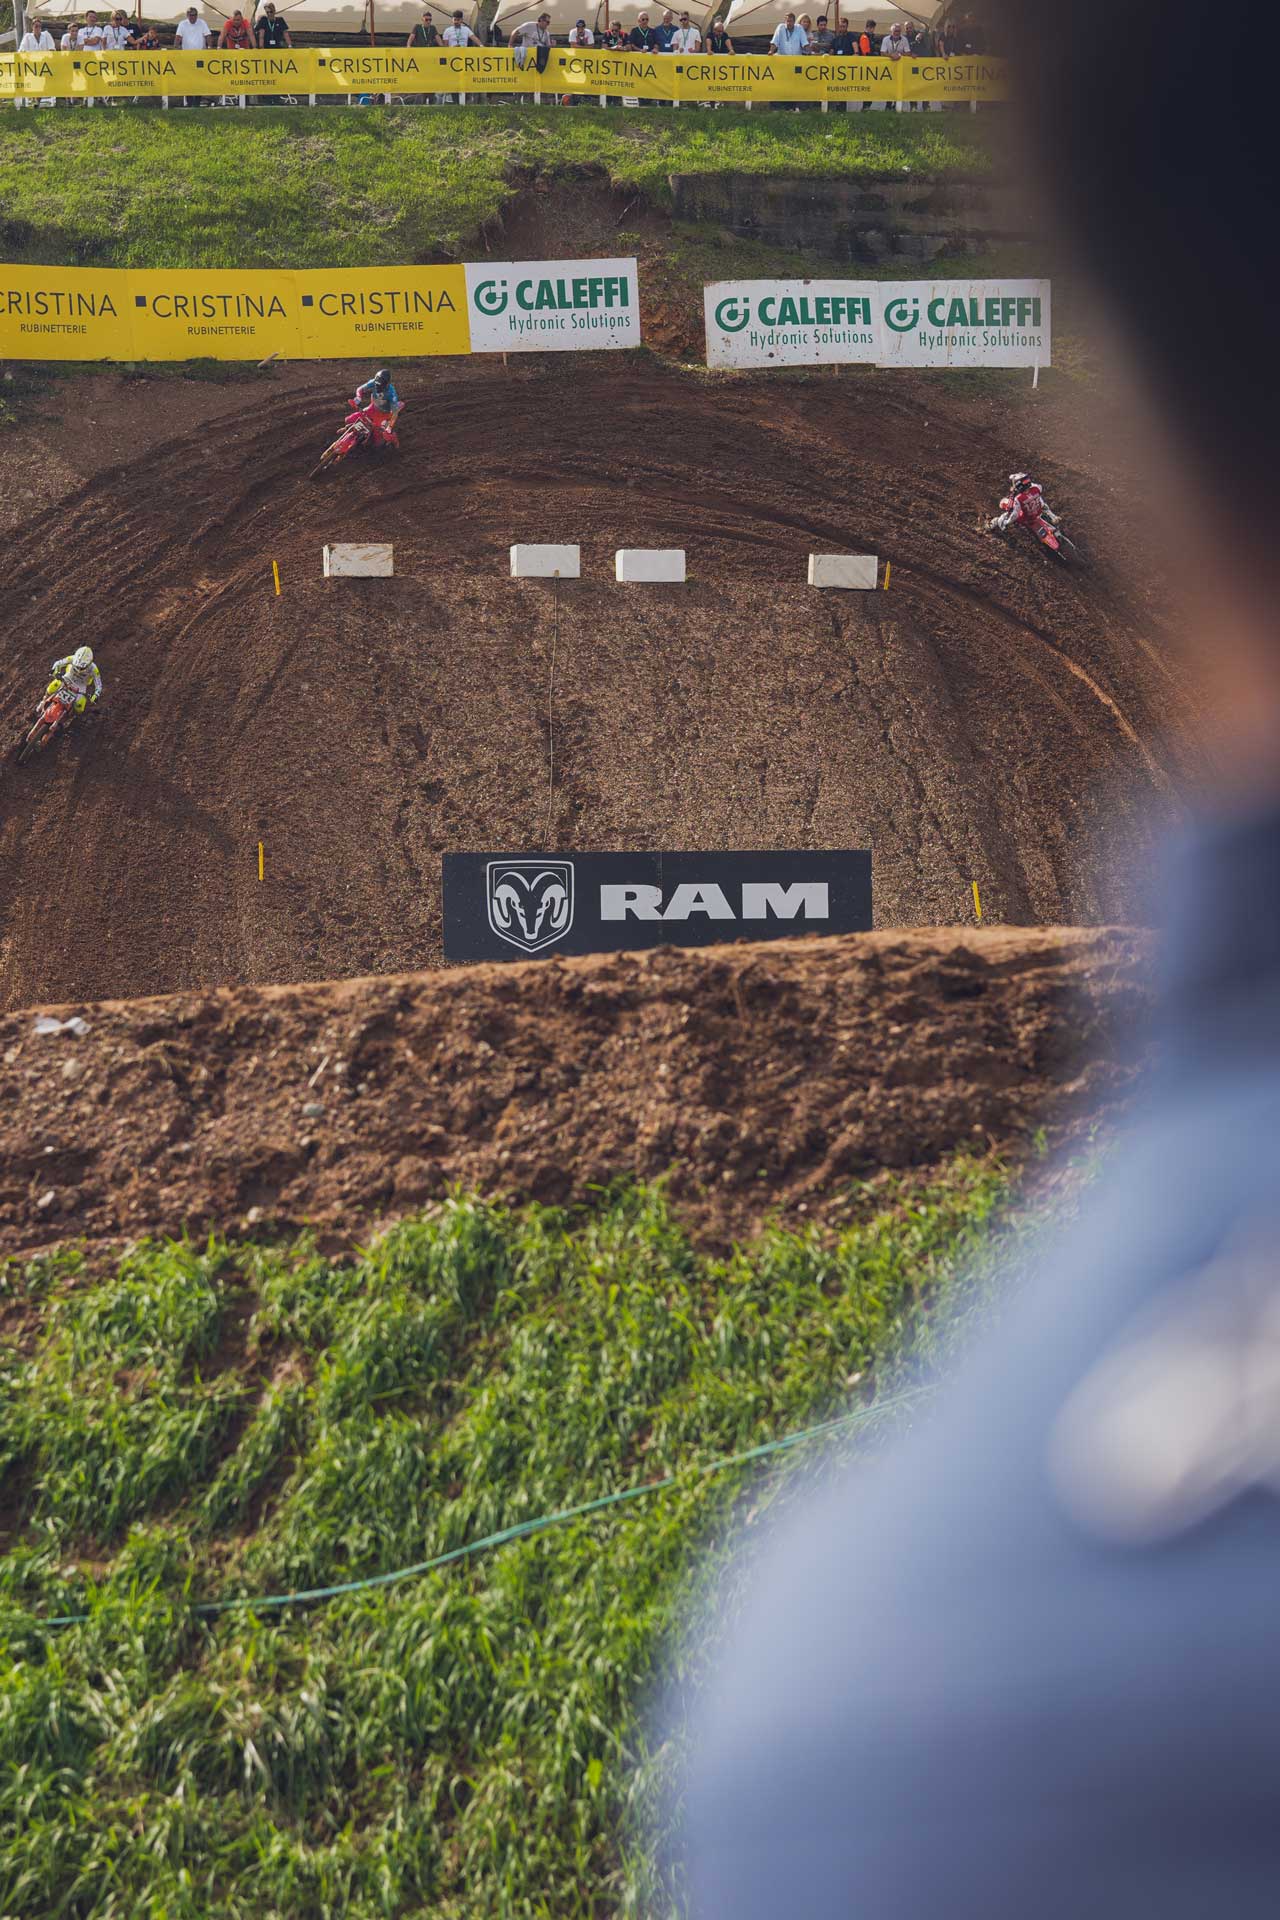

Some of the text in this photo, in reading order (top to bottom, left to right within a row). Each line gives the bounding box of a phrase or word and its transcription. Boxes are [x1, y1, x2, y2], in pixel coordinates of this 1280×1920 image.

[84, 60, 176, 76] CRISTINA
[207, 59, 298, 75] CRISTINA
[329, 58, 420, 73] CRISTINA
[569, 58, 657, 79] CRISTINA
[686, 65, 775, 81] CRISTINA
[805, 65, 893, 81] CRISTINA
[351, 77, 398, 85] RUBINETTERIE
[590, 79, 635, 88] RUBINETTERIE
[516, 276, 629, 311] CALEFFI
[152, 294, 287, 318] CRISTINA
[319, 290, 456, 316] CRISTINA
[758, 297, 871, 326] CALEFFI
[927, 297, 1042, 327] CALEFFI
[20, 323, 87, 334] RUBINETTERIE
[354, 321, 424, 332] RUBINETTERIE
[509, 311, 631, 332] Hydronic Solutions
[187, 326, 256, 336] RUBINETTERIE
[750, 328, 873, 349] Hydronic Solutions
[919, 331, 1042, 349] Hydronic Solutions
[600, 883, 829, 921] RAM
